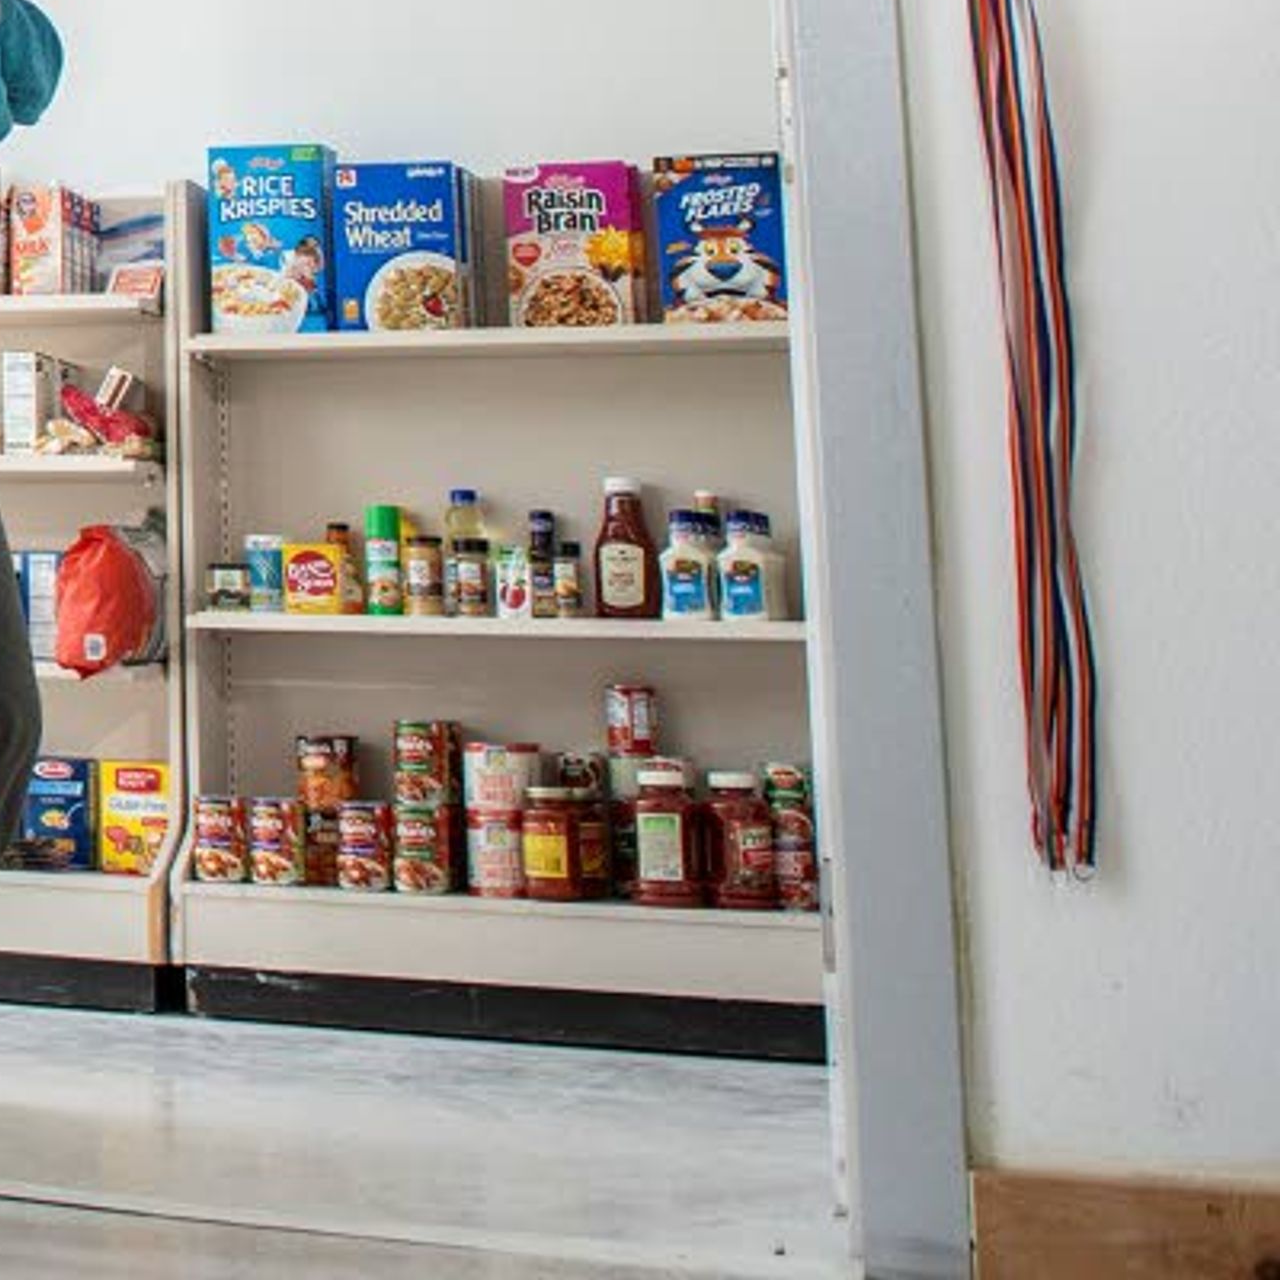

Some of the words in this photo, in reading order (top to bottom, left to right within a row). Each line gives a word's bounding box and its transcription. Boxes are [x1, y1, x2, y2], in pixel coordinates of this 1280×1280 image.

[242, 175, 294, 197] RICE
[220, 197, 318, 222] KRISPIES
[343, 198, 443, 223] Shredded
[526, 187, 604, 214] Raisin
[537, 210, 597, 235] Bran
[344, 224, 412, 249] Wheat
